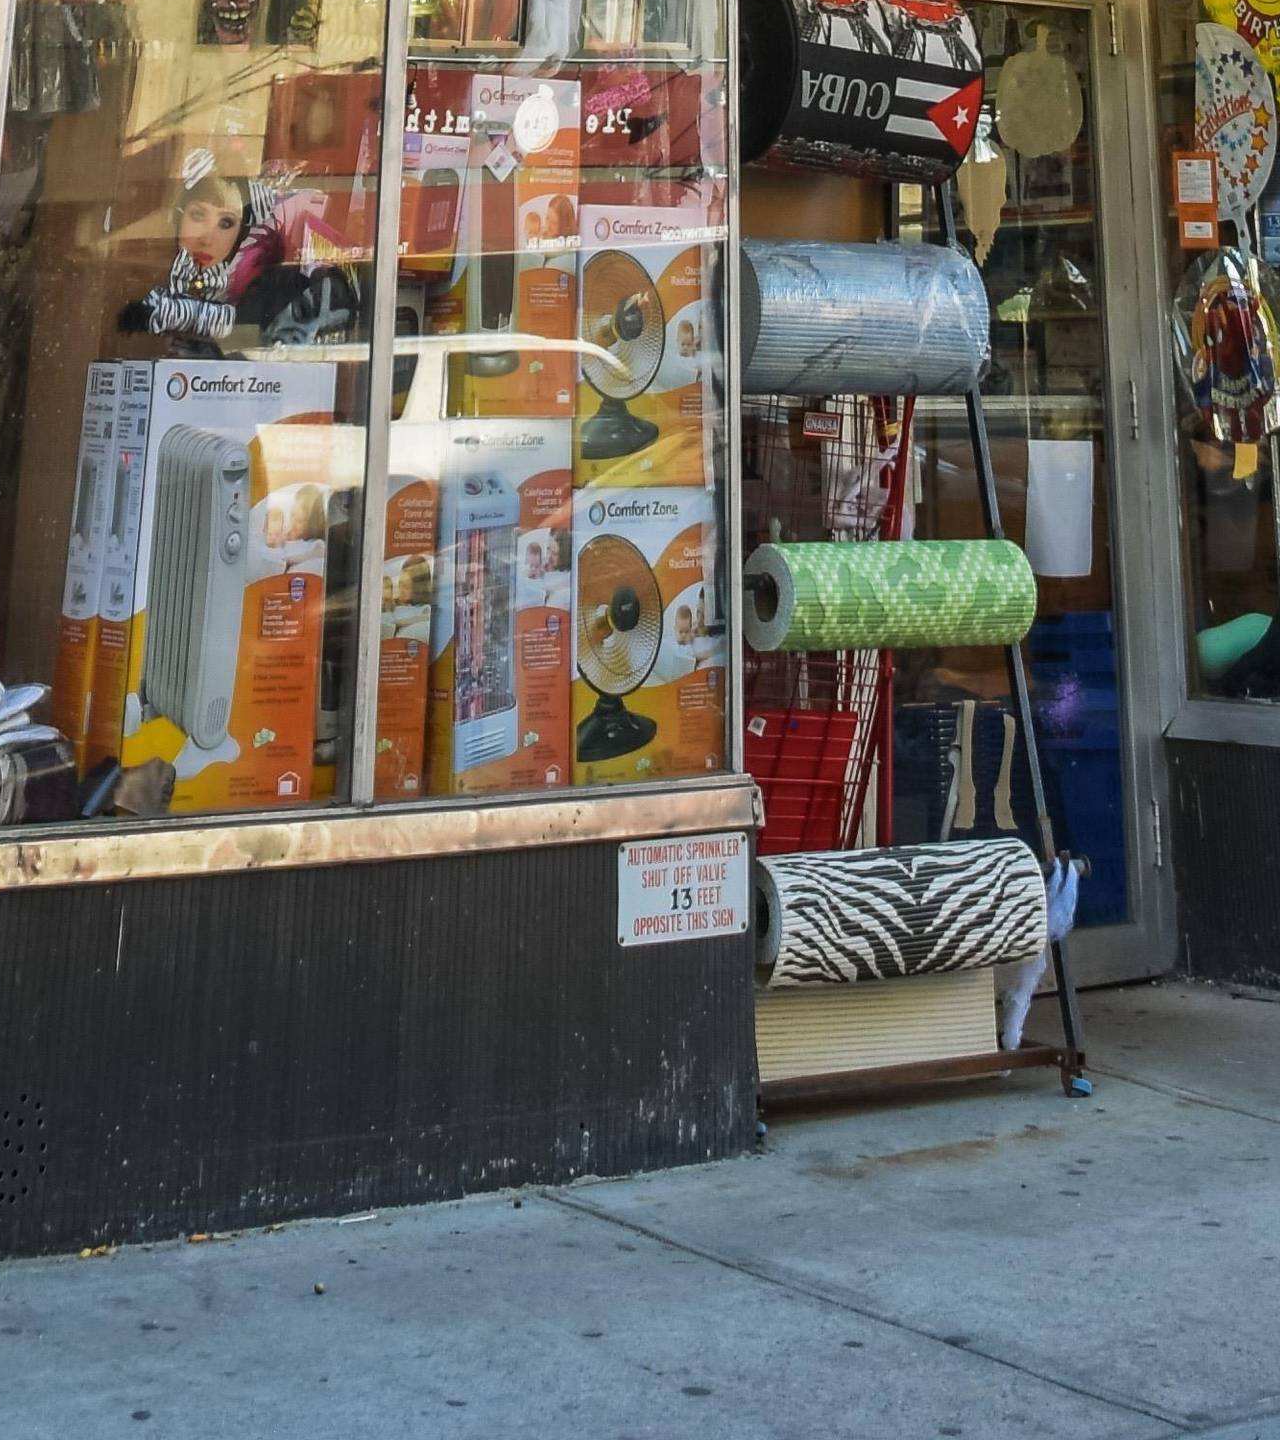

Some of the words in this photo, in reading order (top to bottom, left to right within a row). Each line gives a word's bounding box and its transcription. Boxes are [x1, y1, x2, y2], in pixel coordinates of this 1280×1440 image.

[801, 70, 891, 120] CUBA
[612, 221, 652, 236] Comfort
[191, 375, 243, 394] Comfort
[248, 377, 282, 394] Zone
[521, 434, 544, 446] Zone
[607, 502, 650, 517] Comfort
[653, 502, 679, 517] Zone
[627, 844, 683, 866] AUTOMATIC
[686, 838, 740, 861] SPRINKLER
[642, 868, 668, 889] SHUT
[674, 865, 693, 885] OFF
[697, 863, 727, 883] VALVE
[670, 887, 693, 910] 13
[697, 886, 721, 906] FEET
[633, 913, 683, 937] OPPOSITE
[687, 911, 708, 932] THIS
[712, 907, 735, 928] SIGN
